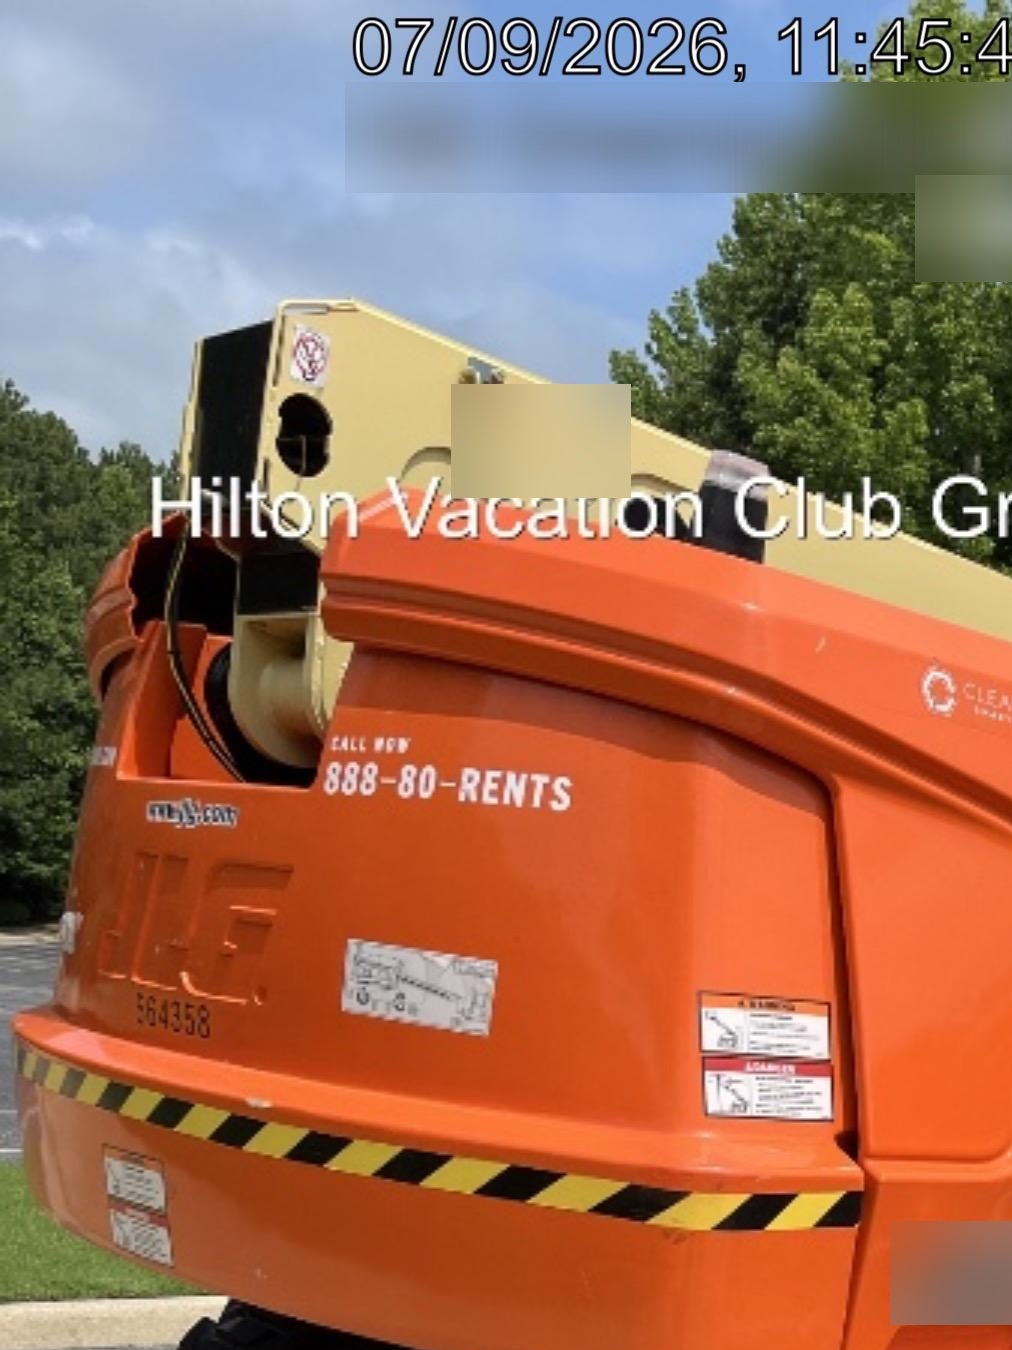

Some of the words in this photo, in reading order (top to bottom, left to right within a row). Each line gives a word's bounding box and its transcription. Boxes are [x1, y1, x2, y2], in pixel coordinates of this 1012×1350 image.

[331, 736, 367, 752] CALL
[323, 761, 574, 812] 888-80-RENTS
[136, 993, 211, 1040] 564358
